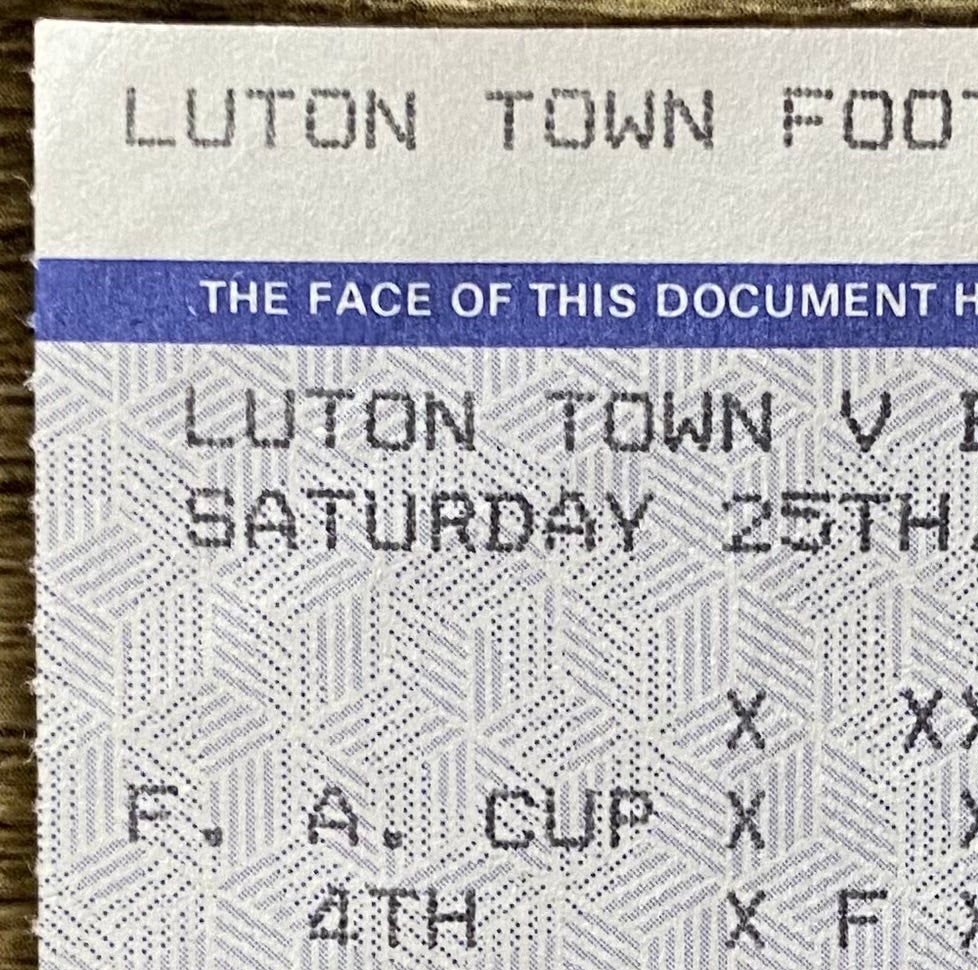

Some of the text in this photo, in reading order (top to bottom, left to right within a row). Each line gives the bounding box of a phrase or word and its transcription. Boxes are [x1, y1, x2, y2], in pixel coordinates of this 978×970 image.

[124, 87, 417, 152] LUTON
[485, 87, 716, 152] TOWN
[200, 280, 288, 316] THE
[309, 281, 430, 317] FACE
[451, 282, 512, 318] OF
[530, 282, 637, 318] THIS
[655, 283, 937, 319] DOCUMENT
[184, 386, 477, 452] LUTON
[549, 389, 773, 453] TOWN
[838, 391, 895, 453] V
[184, 488, 655, 553] SATURDAY
[727, 688, 765, 749] X
[126, 784, 654, 850] F. A. CUP
[727, 788, 765, 849] X
[306, 885, 477, 949] 4TH
[725, 889, 765, 949] X
[836, 889, 889, 949] F
